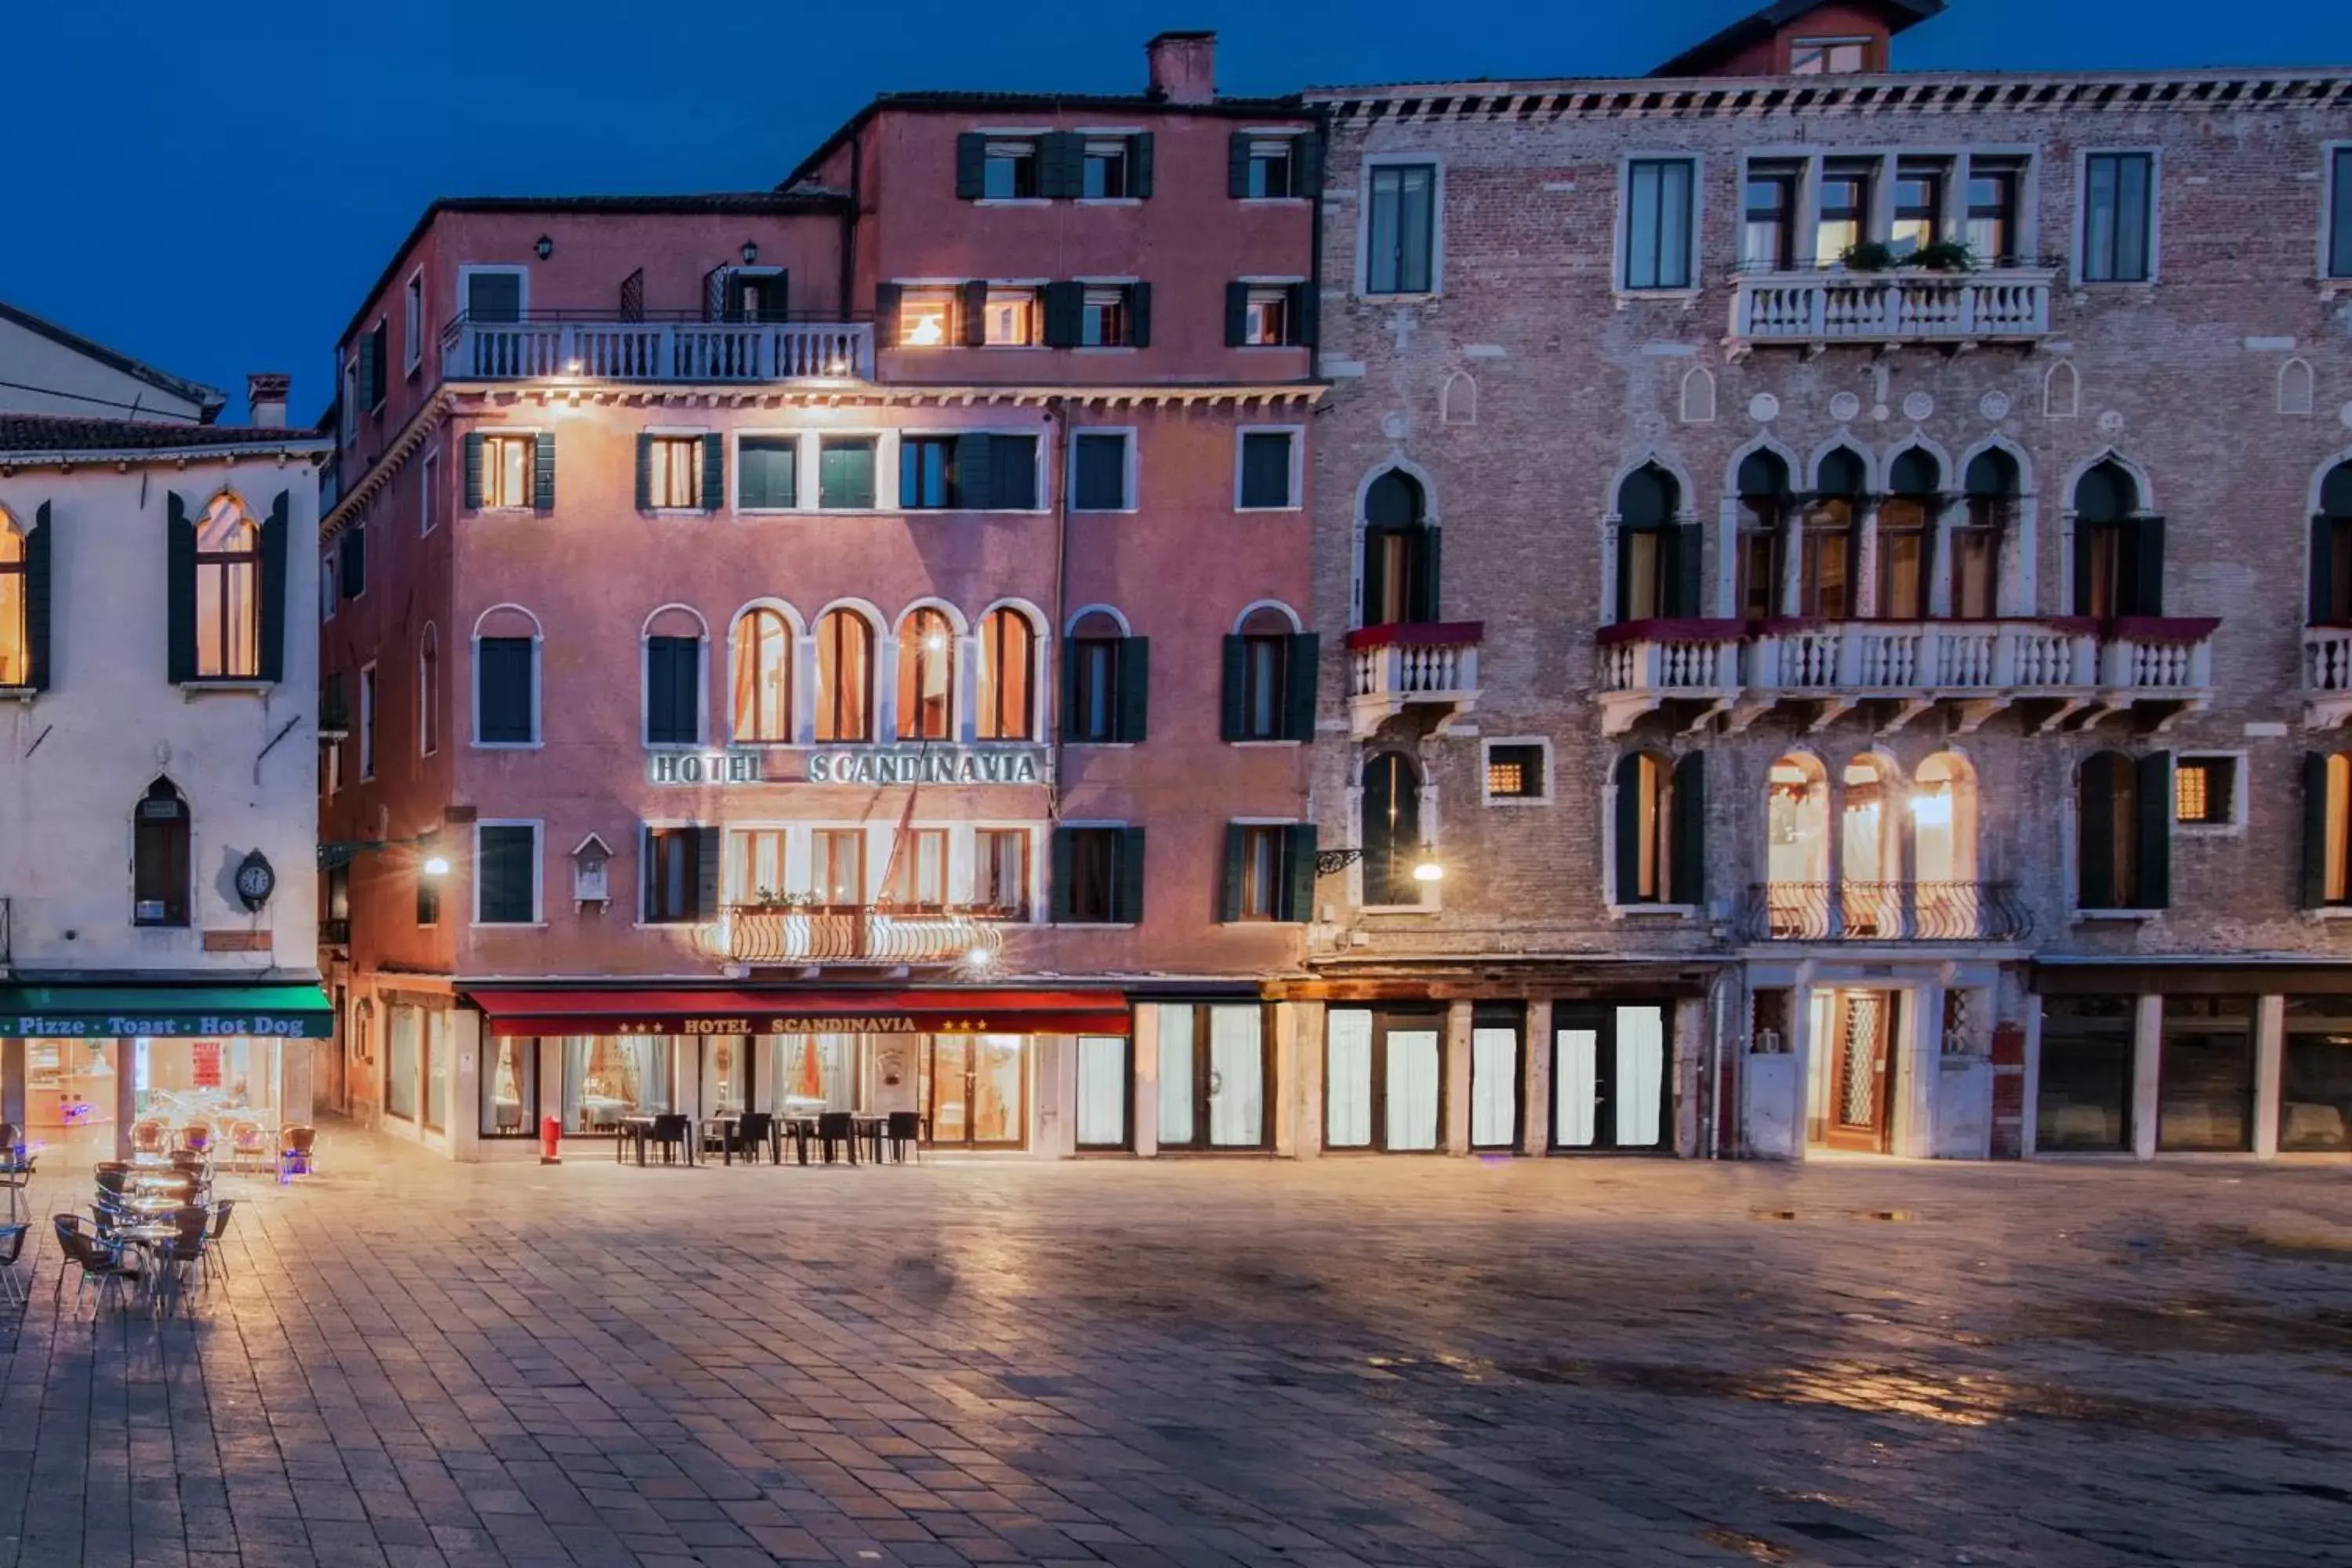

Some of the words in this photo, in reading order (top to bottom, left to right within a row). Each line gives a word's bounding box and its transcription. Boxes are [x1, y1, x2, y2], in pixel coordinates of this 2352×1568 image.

[655, 754, 761, 783] HOTEL
[809, 753, 1036, 783] SCANDINAVIA
[19, 1017, 85, 1034] Pizze
[108, 1017, 176, 1034] Toast
[200, 1017, 247, 1034] Hot
[254, 1017, 303, 1038] Dog
[684, 1019, 751, 1033] HOTEL
[771, 1018, 916, 1033] SCANDINAVIA
